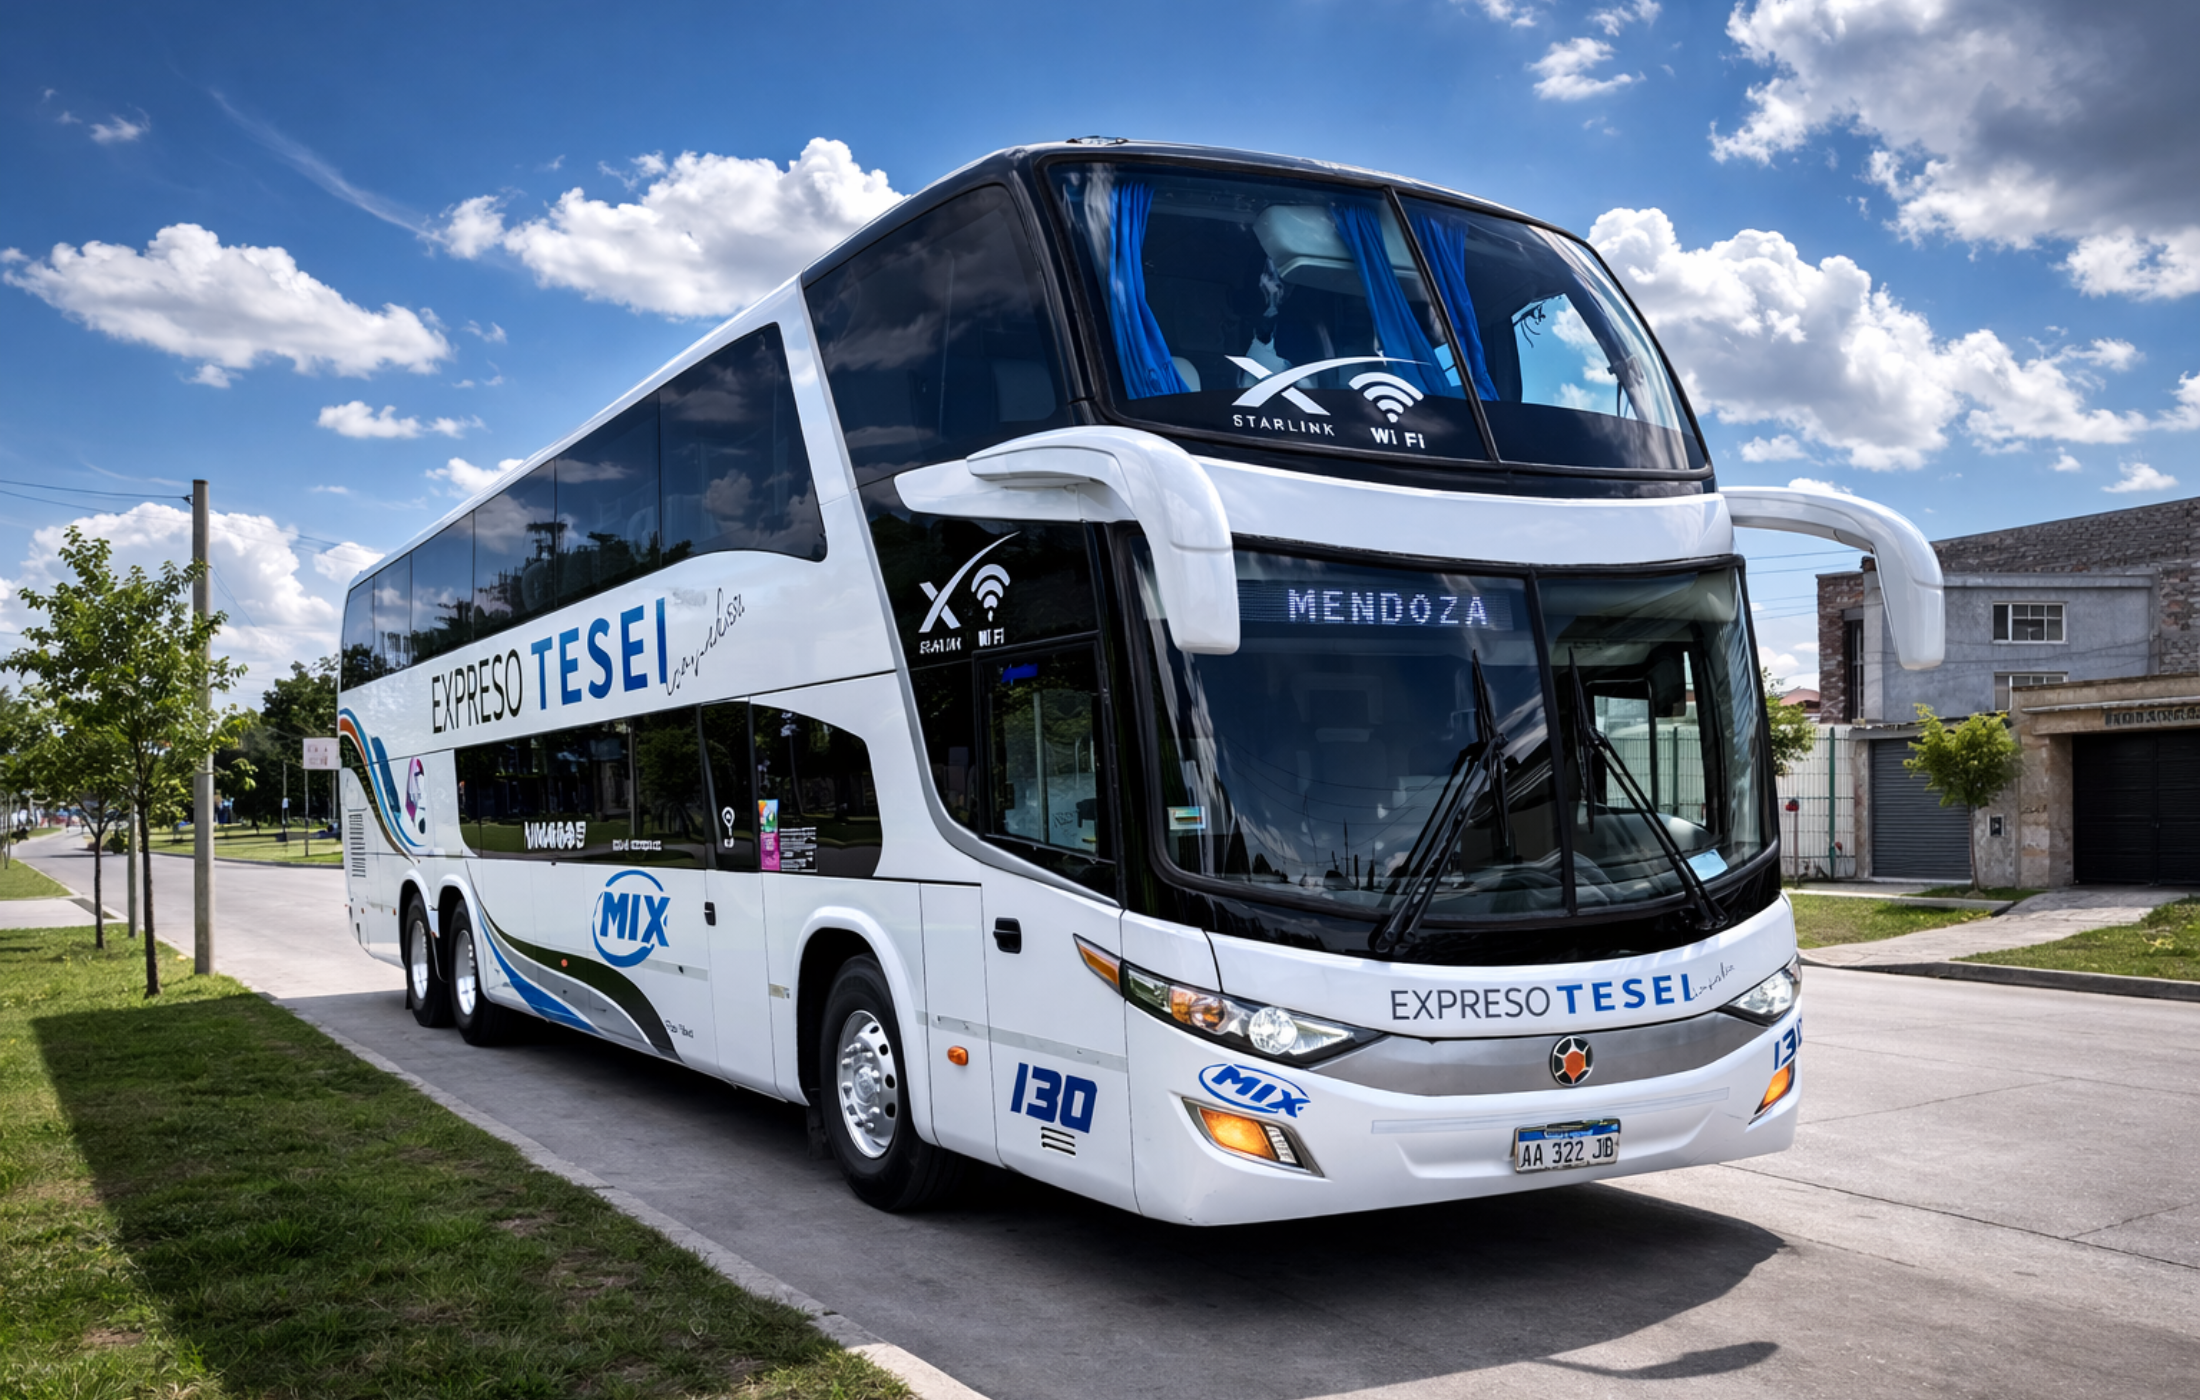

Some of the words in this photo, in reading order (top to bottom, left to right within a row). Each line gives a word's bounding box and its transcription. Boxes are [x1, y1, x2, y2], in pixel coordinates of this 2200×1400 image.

[1233, 414, 1335, 437] STARLINK
[1288, 589, 1487, 625] MENDOZA
[432, 648, 523, 734] EXPRESO
[531, 597, 668, 711] TESEI
[600, 890, 671, 947] MIX
[1391, 986, 1551, 1021] EXPRESO
[1556, 973, 1692, 1014] TESEI
[1010, 1062, 1098, 1134] 130
[1211, 1064, 1311, 1118] MIX
[1520, 1143, 1544, 1168] AA
[1552, 1140, 1585, 1164] 322
